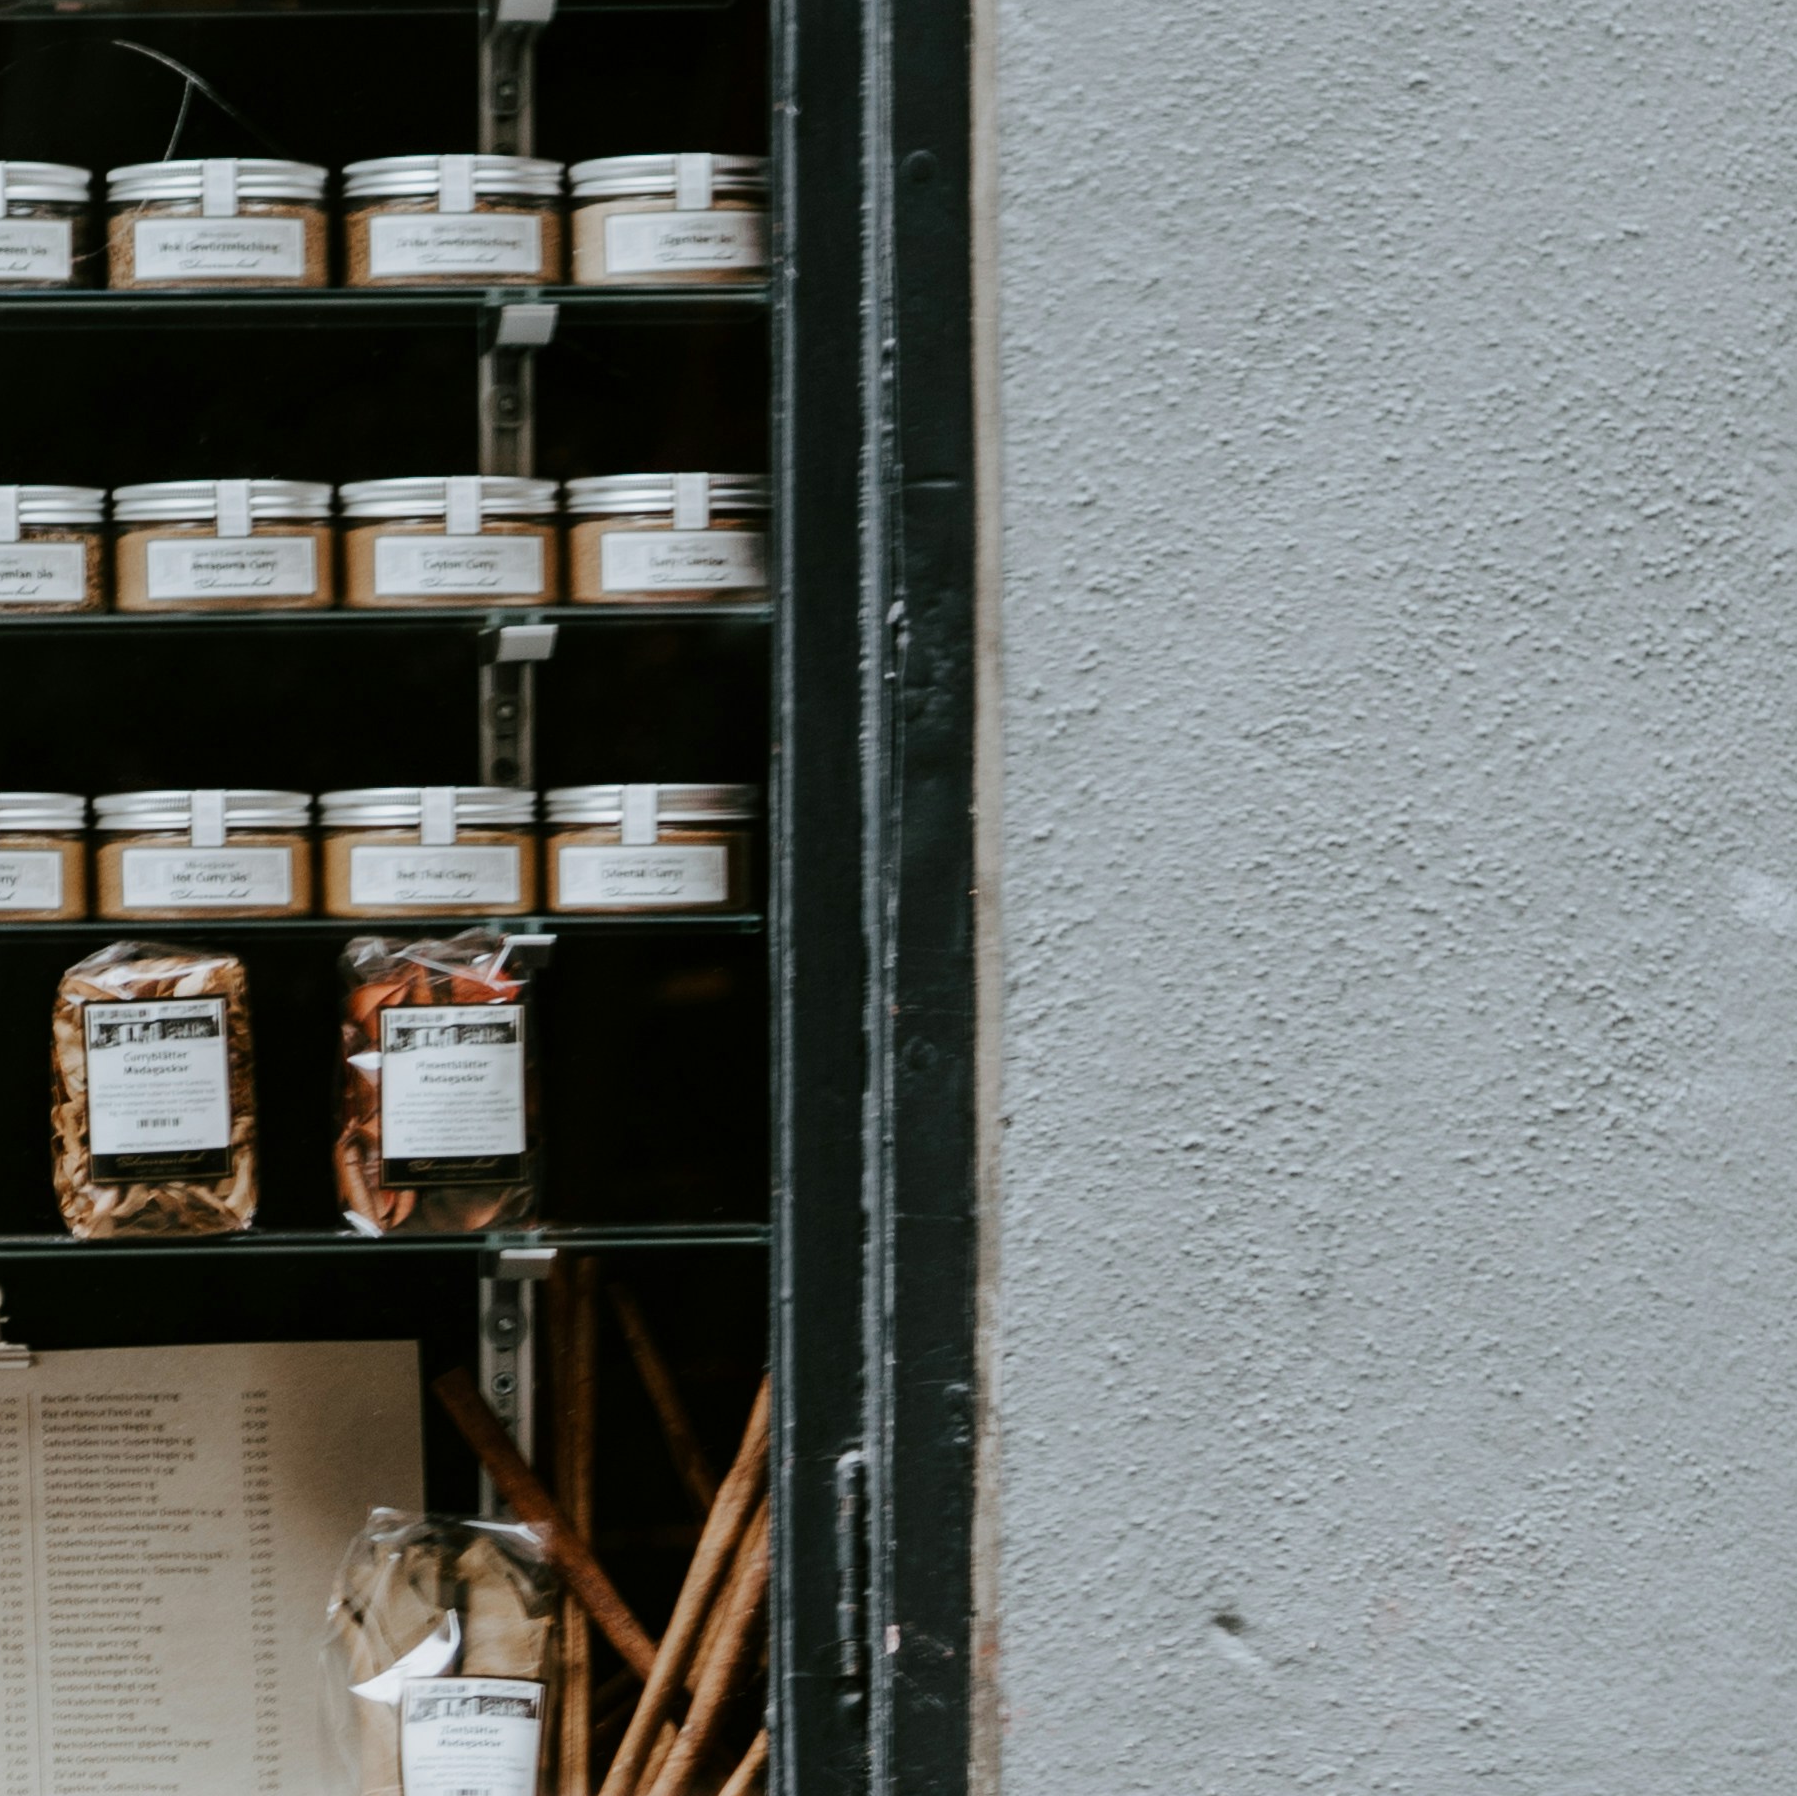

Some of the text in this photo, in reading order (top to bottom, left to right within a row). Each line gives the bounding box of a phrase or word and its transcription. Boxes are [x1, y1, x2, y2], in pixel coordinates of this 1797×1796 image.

[32, 245, 48, 255] bio
[159, 242, 281, 255] Wok Gewürzmischung
[249, 560, 276, 572] Curry
[424, 559, 495, 571] Ceylon Curry
[37, 569, 54, 579] bio
[173, 873, 248, 885] Hot Curry bio
[397, 870, 473, 882] Red Thai Curry
[603, 868, 682, 880] Oriental Curry
[124, 1051, 188, 1063] Curryblätter
[124, 1065, 189, 1076] Madagaskar
[416, 1060, 489, 1070] Pimentblätter
[420, 1074, 485, 1085] Madagaskar
